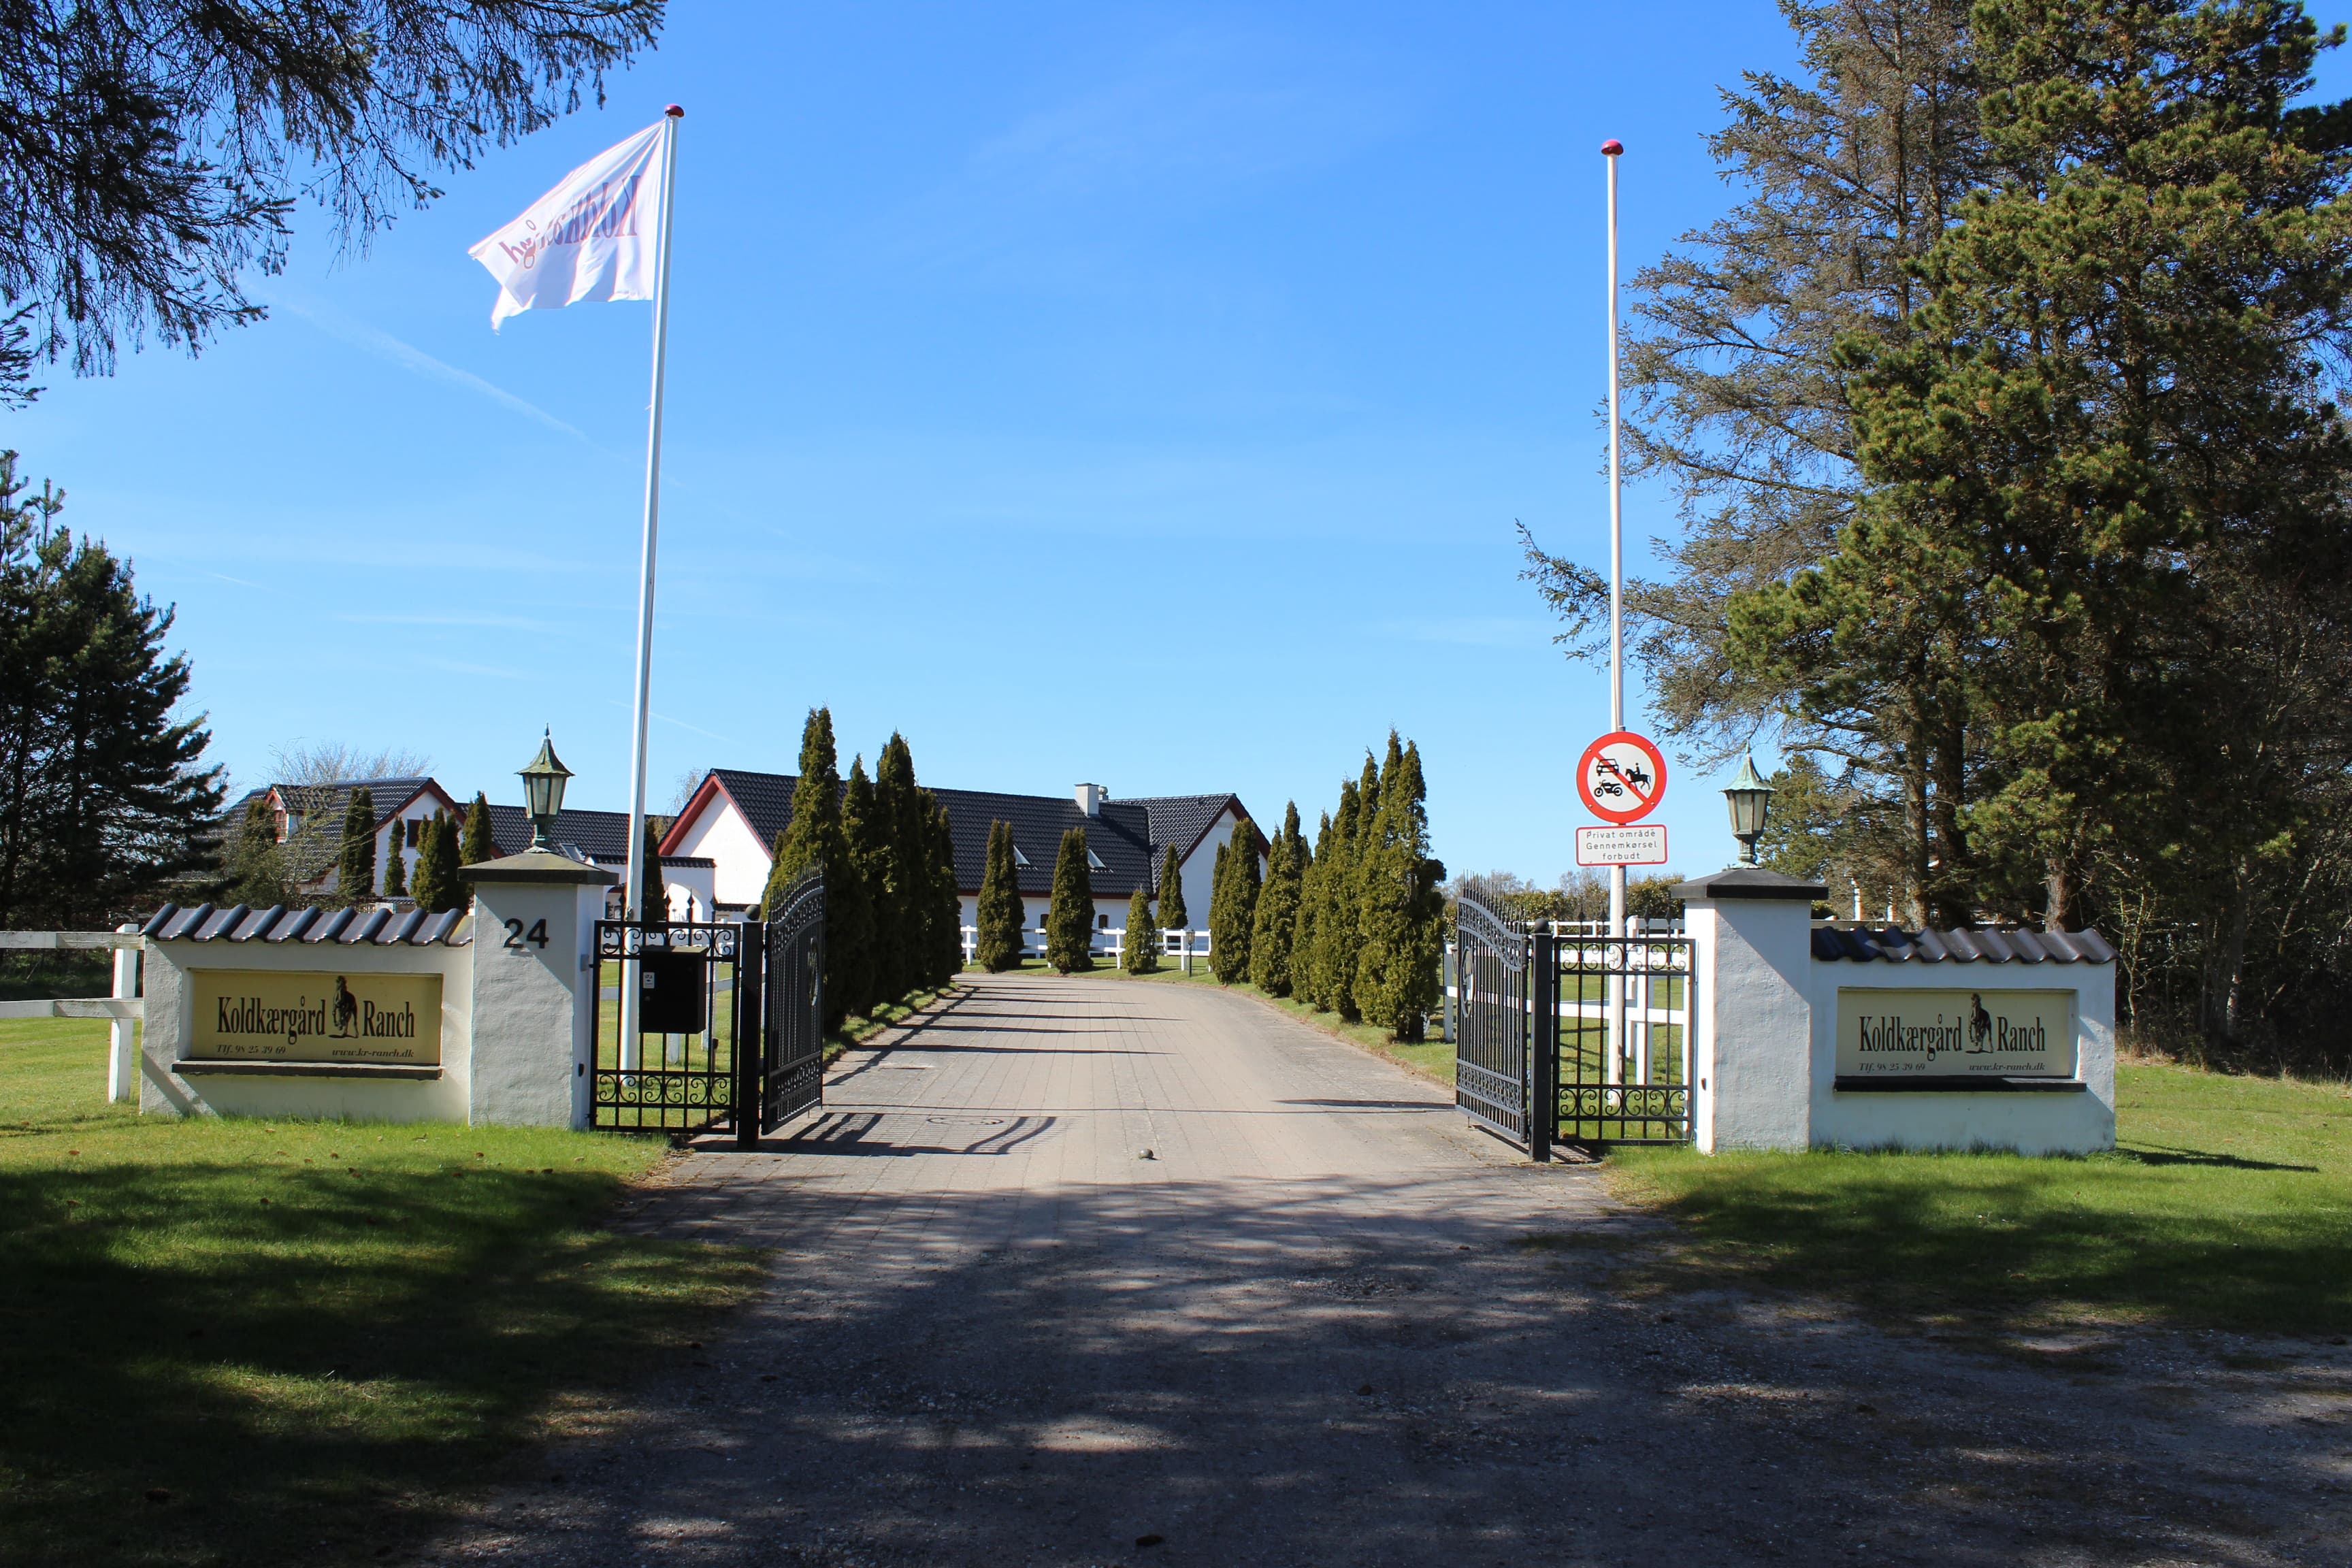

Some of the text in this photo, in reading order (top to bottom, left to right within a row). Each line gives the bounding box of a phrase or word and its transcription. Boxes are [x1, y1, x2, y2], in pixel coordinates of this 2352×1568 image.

[1619, 830, 1656, 838] område
[1586, 840, 1657, 850] Gennemkørsel
[1603, 852, 1640, 860] forbudt
[504, 918, 549, 949] 24
[216, 996, 415, 1045] Koldkærgård Ranch
[1859, 1013, 2046, 1062] Koldkærgård Ranch
[216, 1044, 233, 1056] Tlf.
[248, 1045, 259, 1054] 25
[275, 1045, 286, 1054] 69
[332, 1048, 414, 1058] www.kr-ranch.dk
[1859, 1063, 1874, 1073] Tlf.
[1889, 1063, 1899, 1071] 25
[1915, 1063, 1926, 1071] 69
[1969, 1062, 2046, 1071] www.kr-ranch.dk
